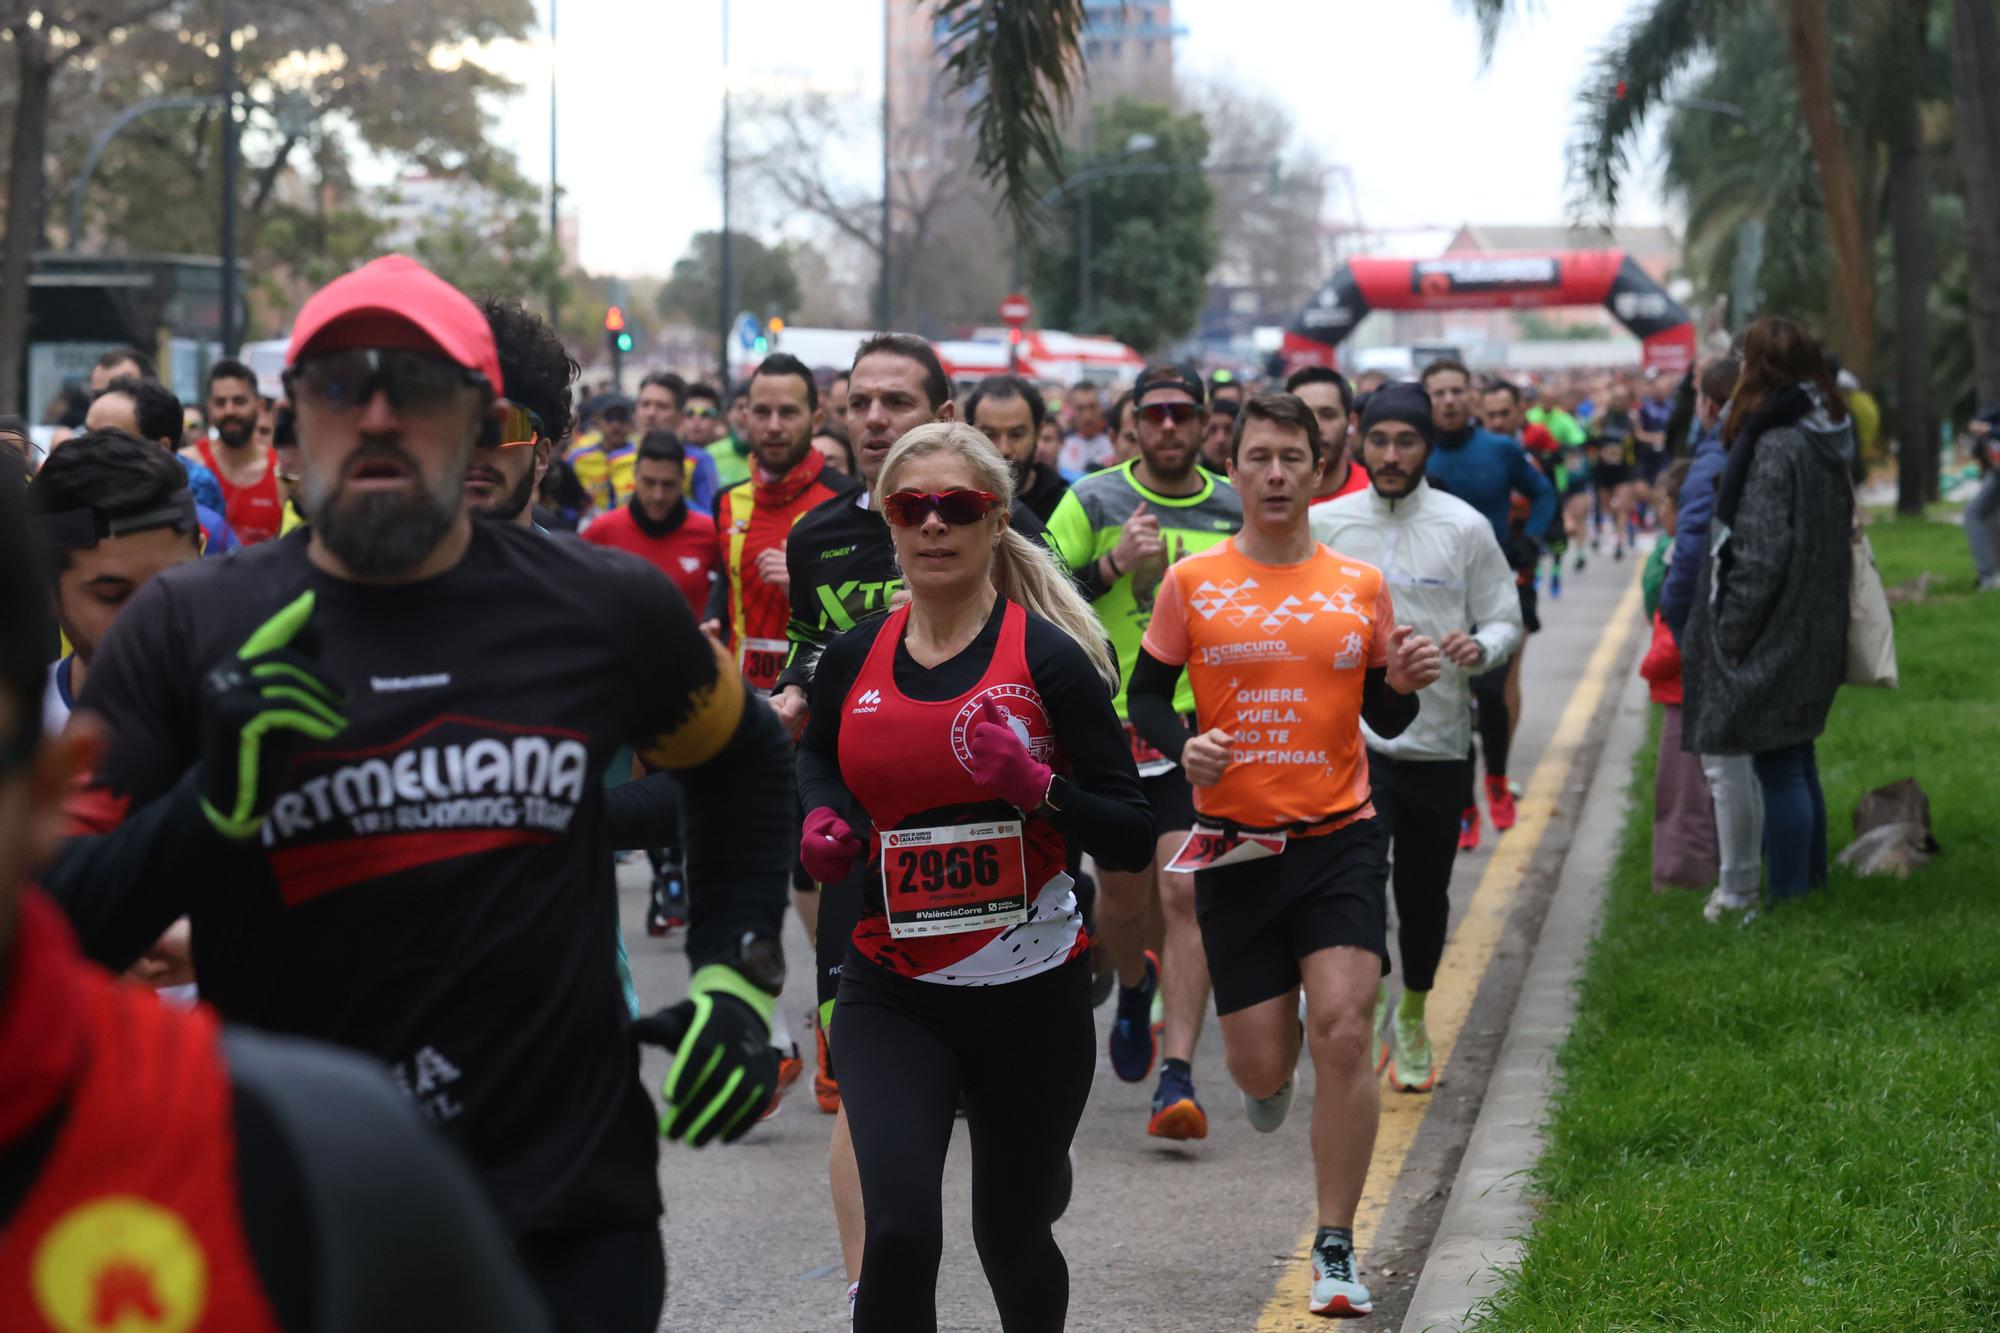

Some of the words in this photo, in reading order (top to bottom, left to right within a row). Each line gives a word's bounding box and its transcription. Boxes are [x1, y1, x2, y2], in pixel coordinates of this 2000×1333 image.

[1201, 646, 1222, 667] 15
[1221, 640, 1288, 655] CIRCUITO
[1236, 687, 1308, 703] QUIERE.
[853, 706, 877, 714] mobel
[961, 700, 979, 717] DE
[1236, 707, 1301, 723] VUELA.
[954, 726, 969, 761] CLUB
[1233, 729, 1261, 743] NO
[1266, 729, 1290, 744] TE
[898, 844, 1001, 894] 2966
[916, 906, 983, 920] #ValènciaCorre
